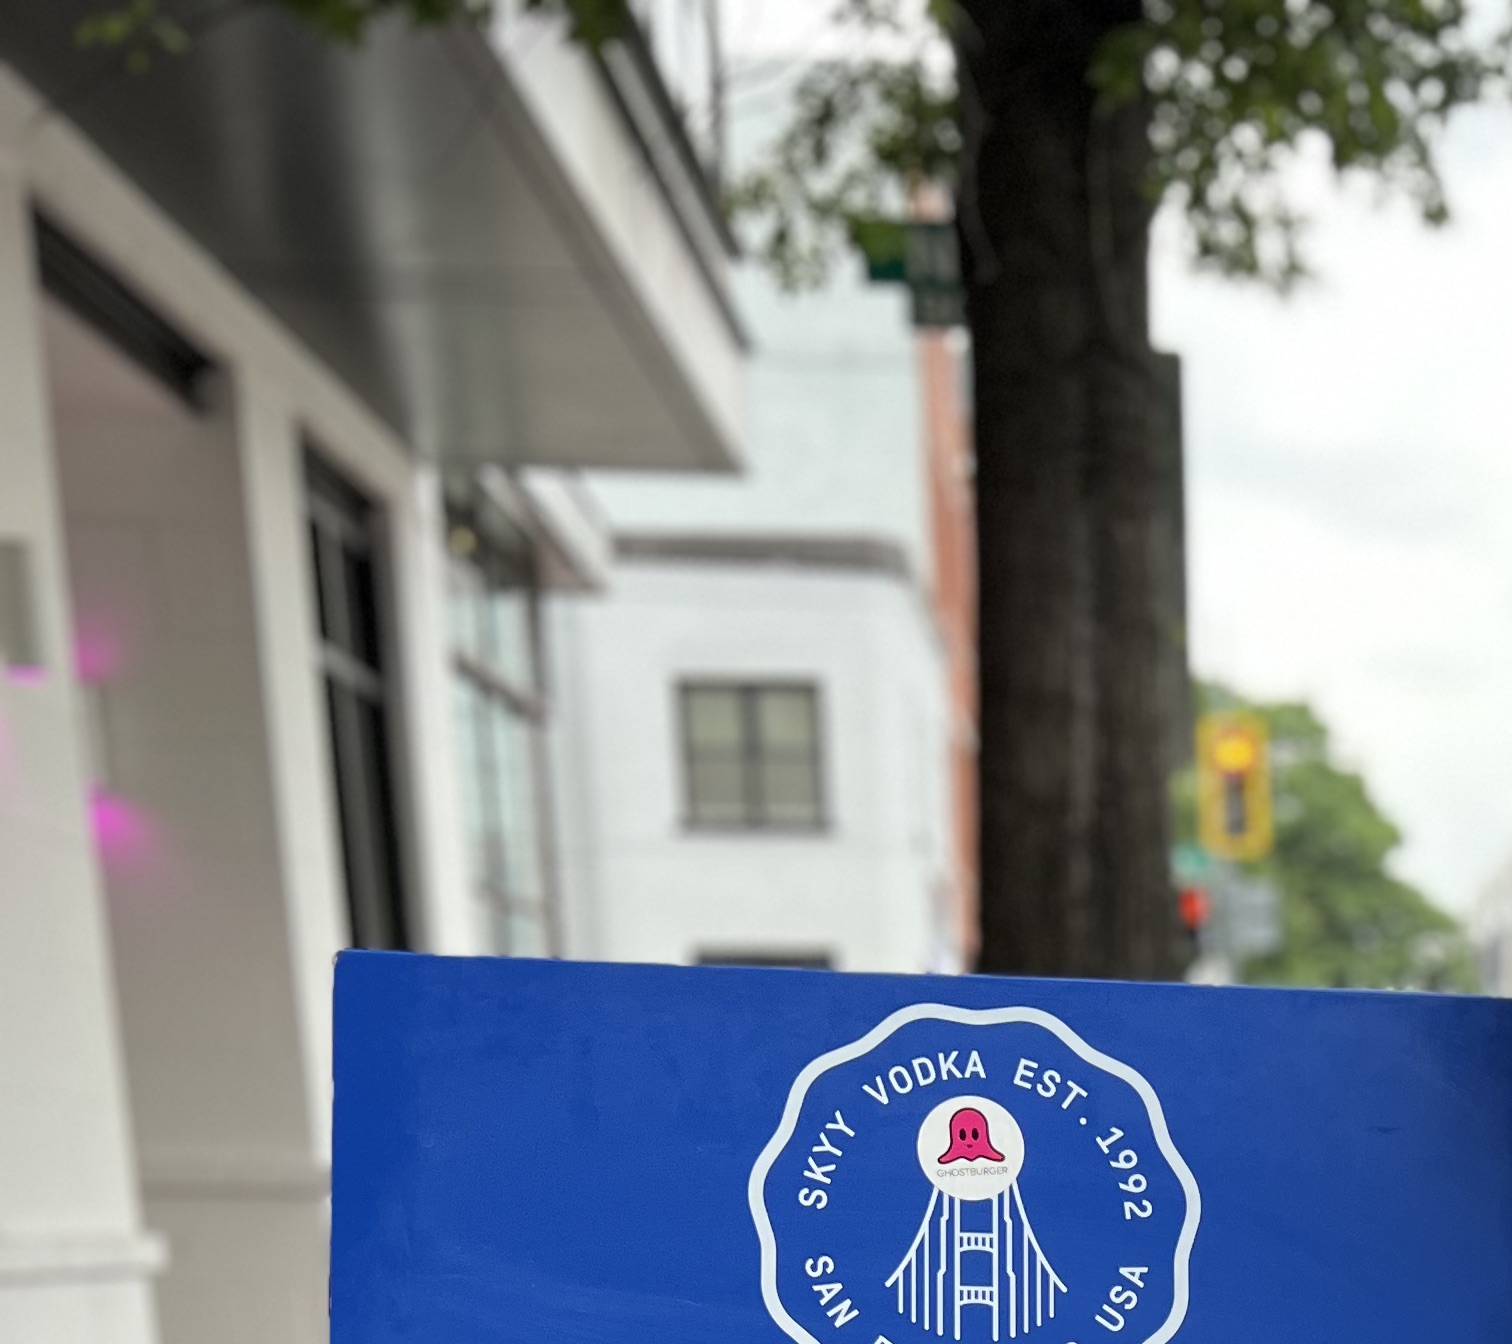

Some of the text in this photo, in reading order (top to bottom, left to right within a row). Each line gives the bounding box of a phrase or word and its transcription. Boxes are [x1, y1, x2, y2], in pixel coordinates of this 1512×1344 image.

[800, 1050, 1153, 1220] SKYY VODKA EST. 1992
[936, 1166, 1008, 1177] GHOSTBURGER
[805, 1255, 859, 1327] SAN
[1095, 1265, 1149, 1332] USA
